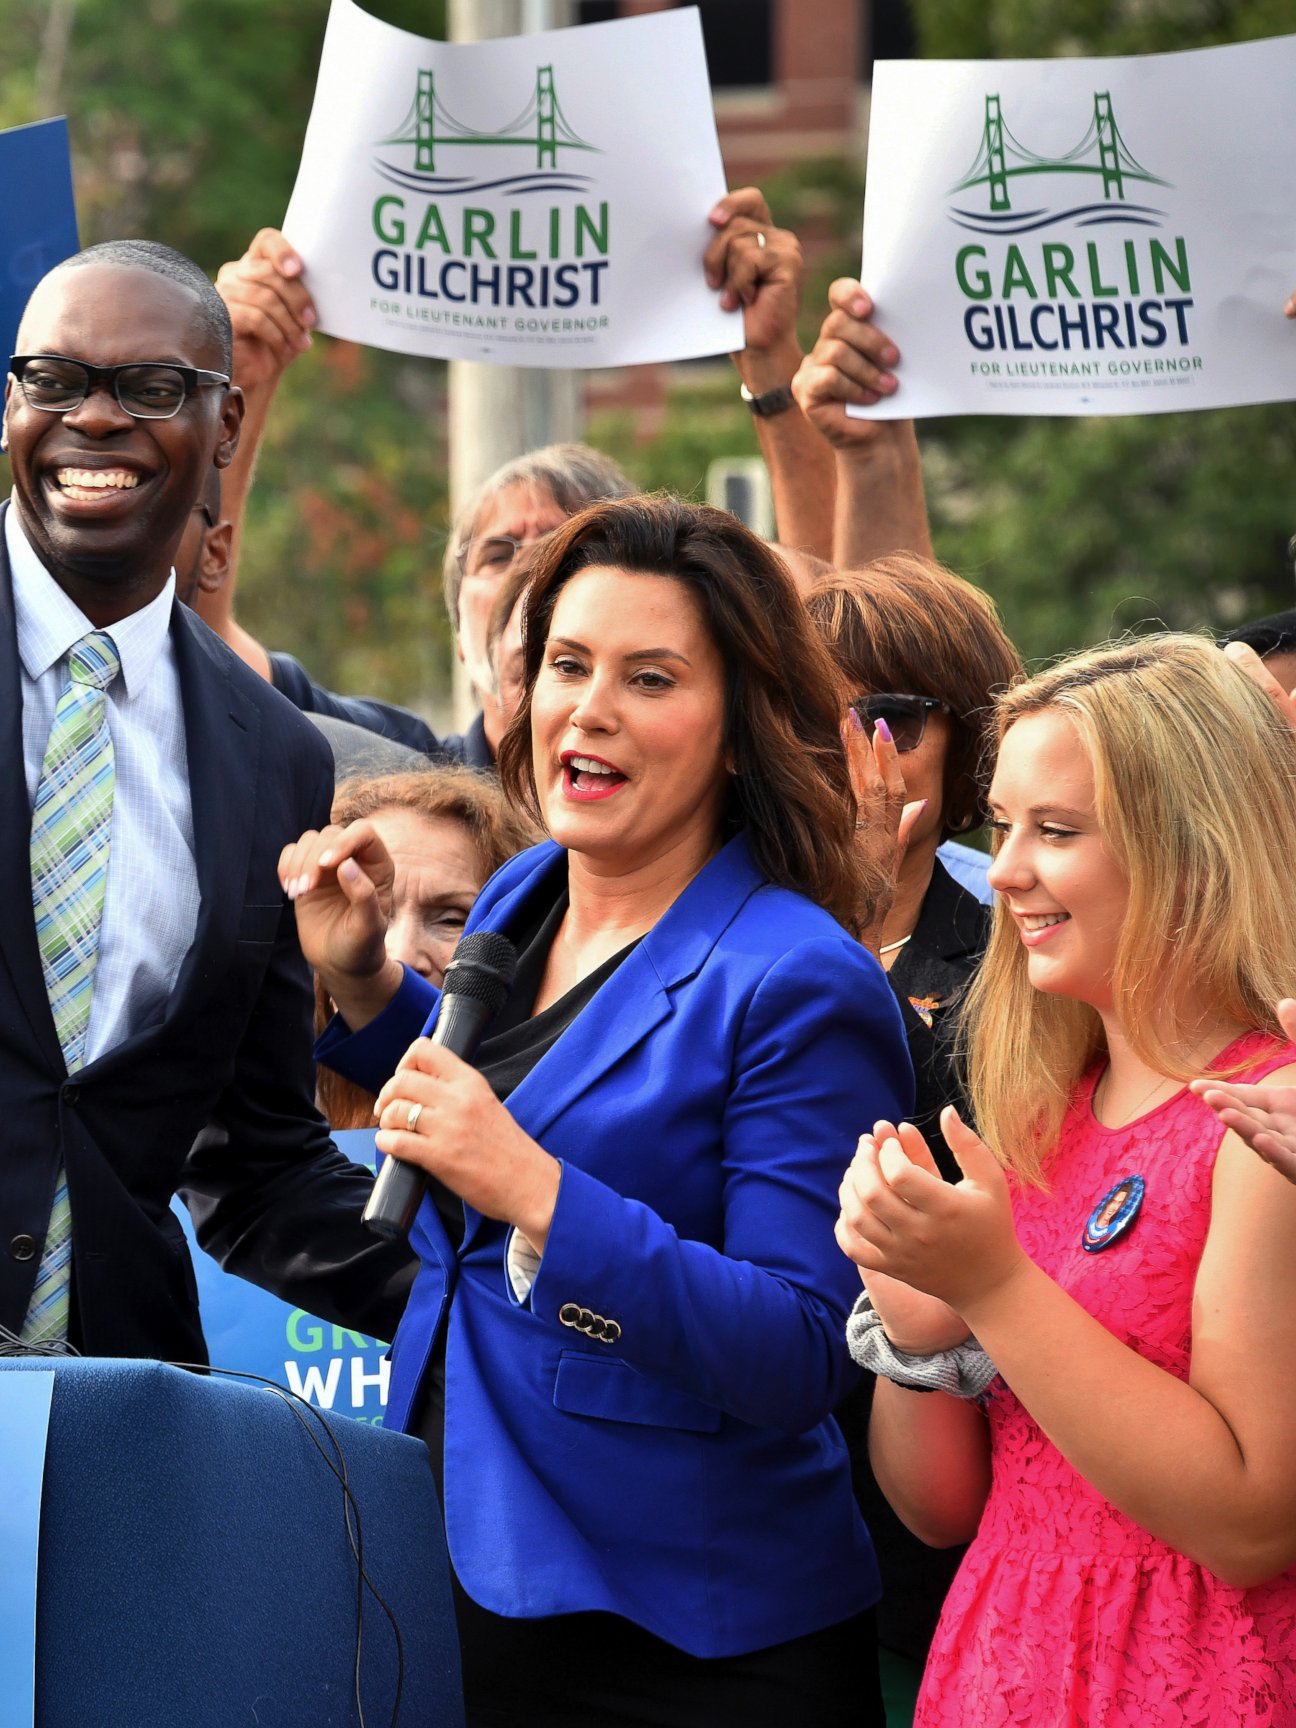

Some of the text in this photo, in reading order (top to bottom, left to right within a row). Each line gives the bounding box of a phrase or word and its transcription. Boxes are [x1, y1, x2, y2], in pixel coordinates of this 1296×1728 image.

[372, 195, 609, 260] GARLIN
[371, 249, 609, 308] GILCHRIST
[955, 236, 1191, 300] GARLIN
[370, 299, 401, 315] FOR
[406, 307, 508, 330] LIEUTENANT
[515, 316, 610, 333] GOVERNOR
[963, 299, 1194, 352] GILCHRIST
[970, 356, 1203, 376] FOR LIEUTENANT GOVERNOR
